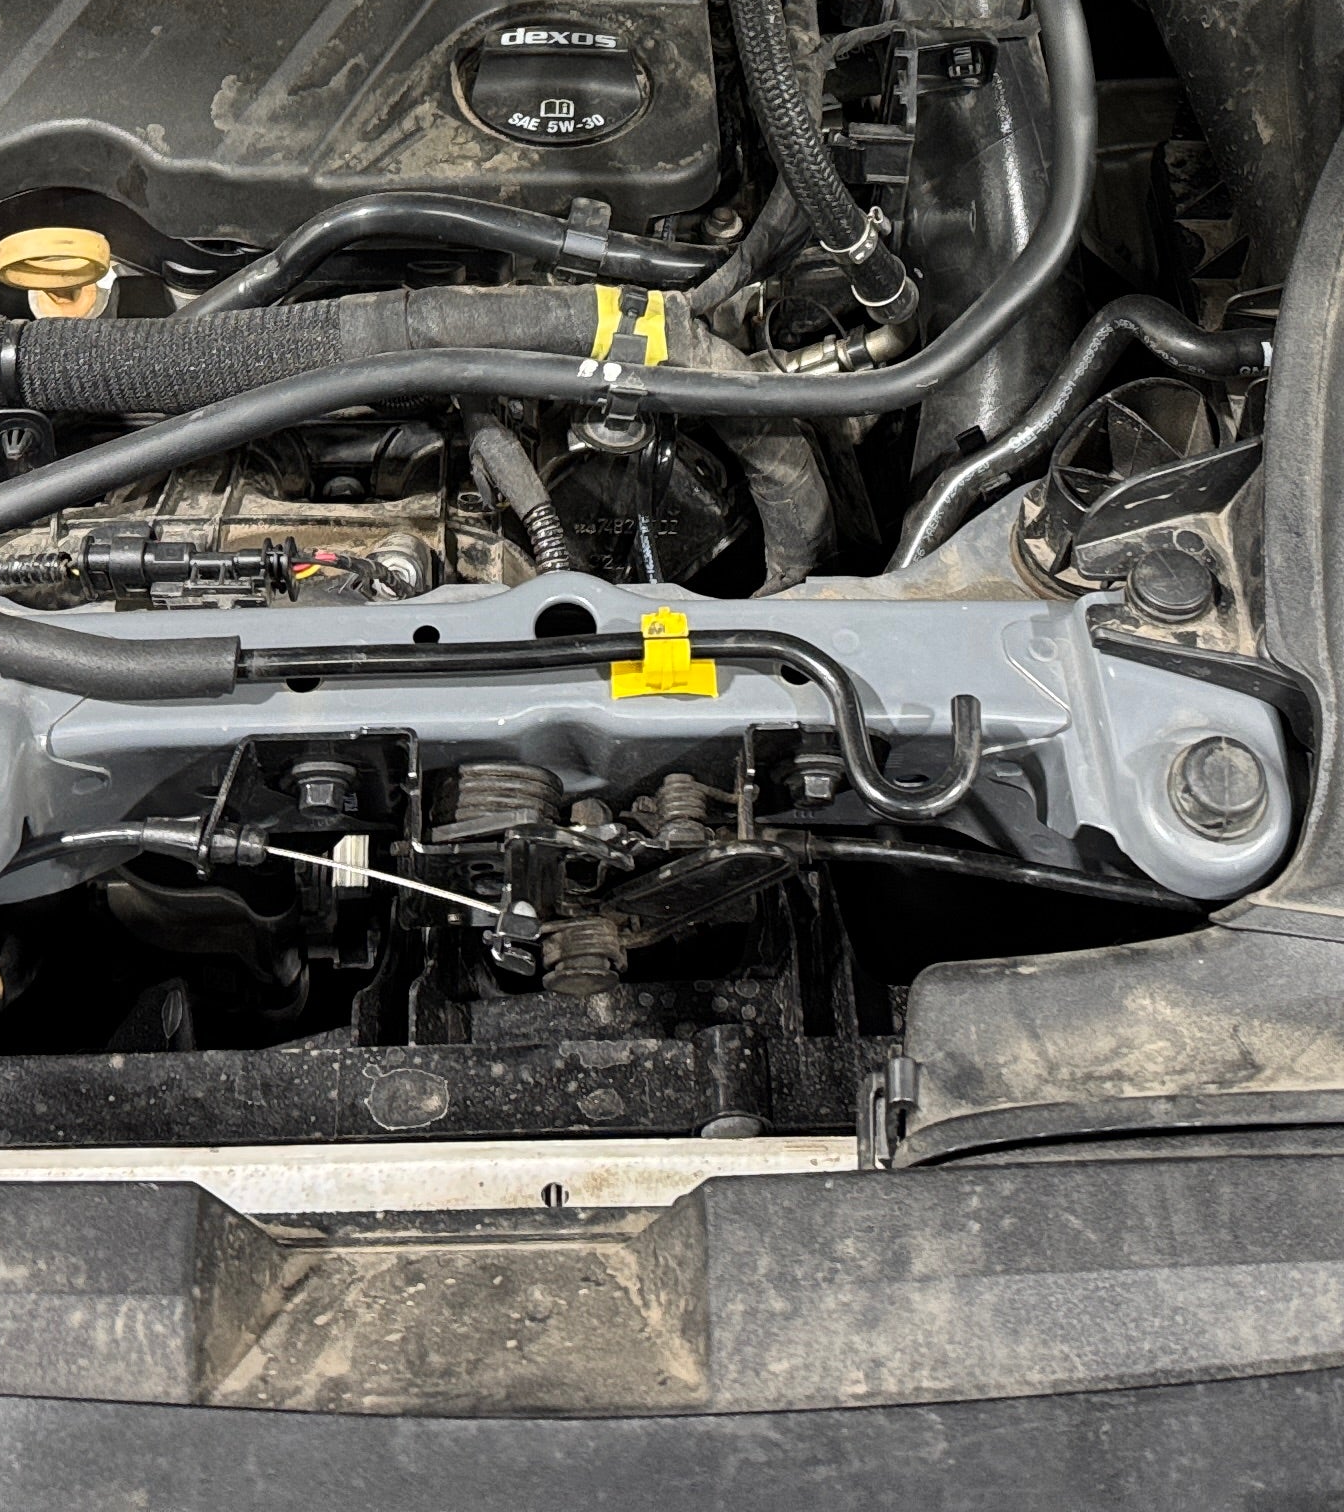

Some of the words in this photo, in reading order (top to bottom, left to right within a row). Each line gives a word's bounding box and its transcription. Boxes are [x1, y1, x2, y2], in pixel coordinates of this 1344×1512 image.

[500, 27, 618, 49] dexos
[507, 112, 541, 131] SAE
[546, 114, 605, 134] 5W-30
